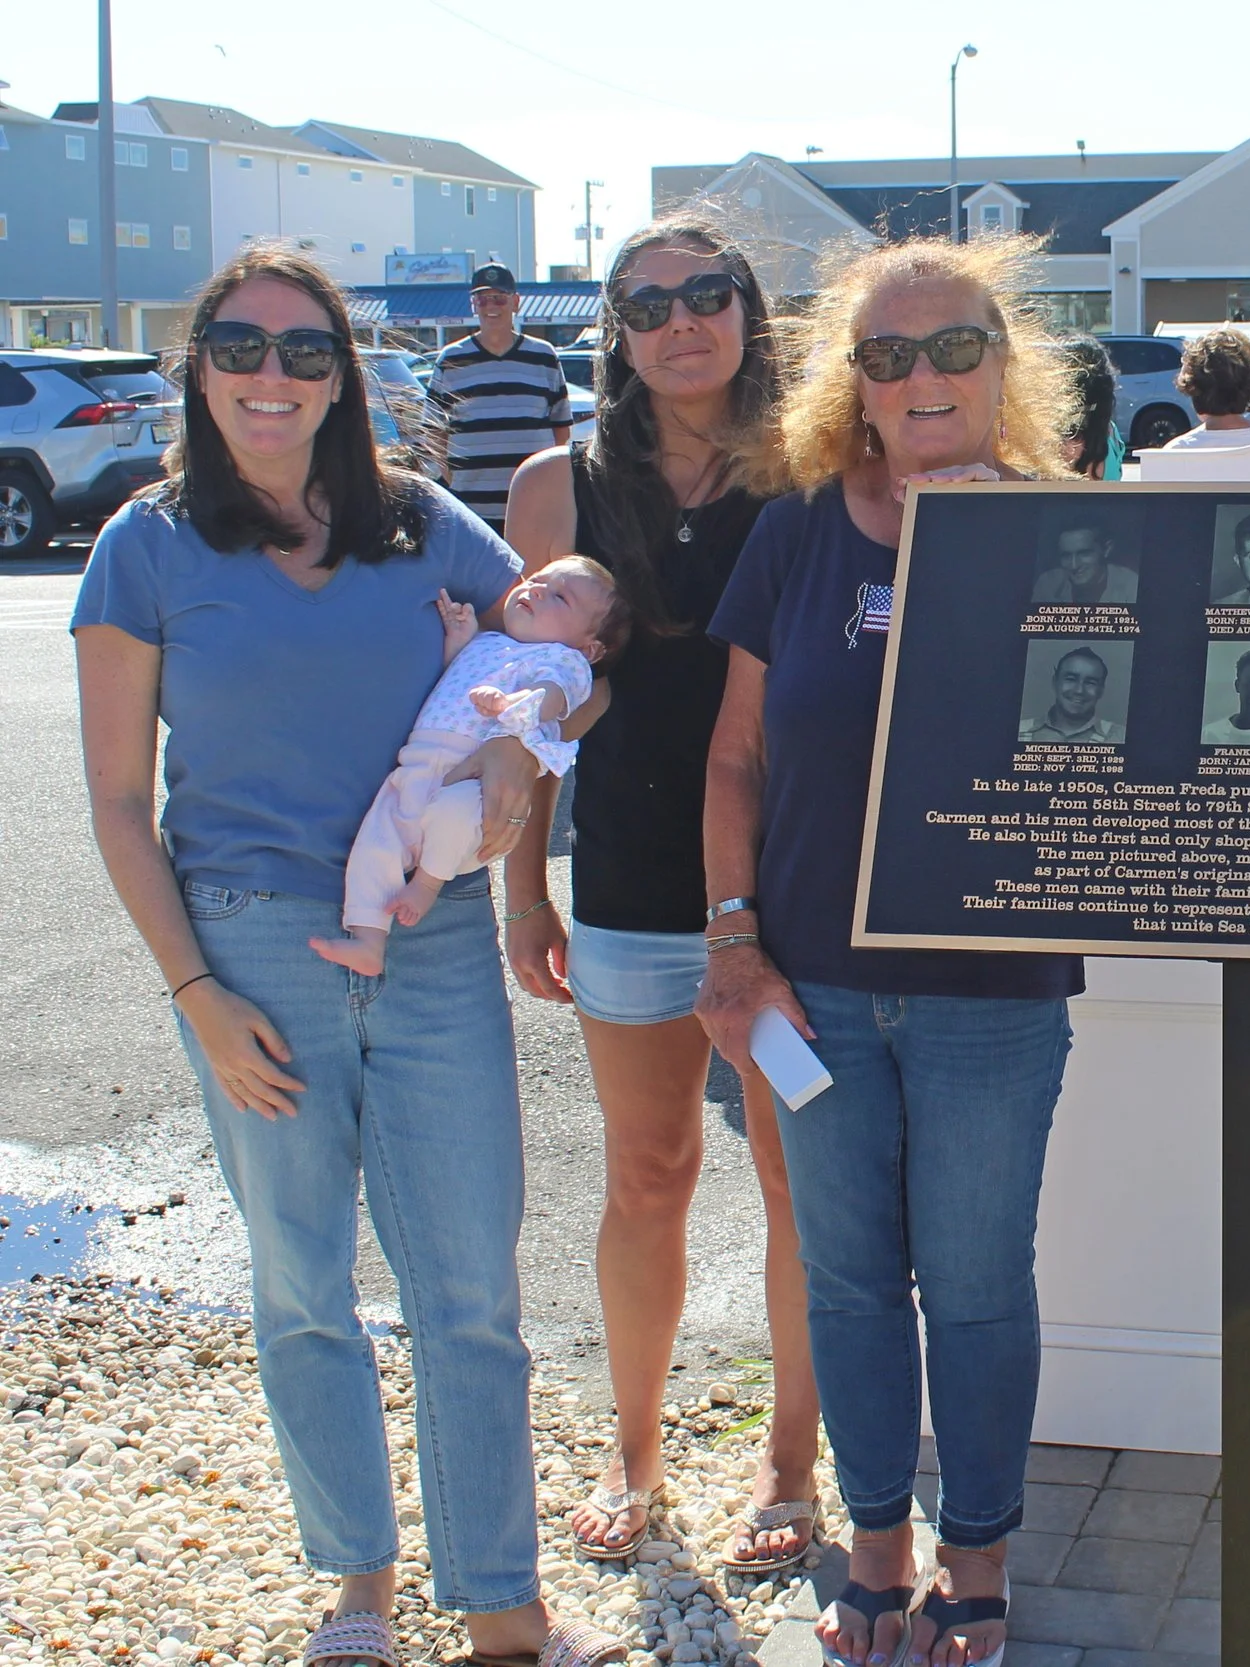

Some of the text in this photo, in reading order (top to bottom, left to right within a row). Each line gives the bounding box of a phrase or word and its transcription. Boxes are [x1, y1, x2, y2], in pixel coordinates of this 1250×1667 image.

[1026, 615, 1057, 623] BORN:
[1085, 616, 1110, 624] 15TH,
[1020, 624, 1044, 632] DIED
[1088, 625, 1115, 633] 24TH,
[1209, 626, 1234, 634] DIED
[1025, 745, 1115, 754] MICHAEL BALDINI
[1214, 748, 1250, 756] FRANK
[1013, 754, 1044, 762] BORN:
[1047, 754, 1074, 762] SEPT.
[1076, 755, 1099, 764] 3RD,
[1199, 757, 1231, 765] BORN:
[1013, 763, 1041, 771] DIED:
[1043, 764, 1066, 772] NOV
[1071, 765, 1098, 773] 10TH,
[973, 778, 990, 791] In
[995, 779, 1019, 791] the
[1024, 780, 1052, 792] late
[1058, 782, 1108, 795] 1950s,
[1114, 782, 1175, 795] Carmen
[1179, 783, 1226, 795] Freda
[1049, 797, 1088, 809] from
[1093, 799, 1129, 810] 58th
[1133, 799, 1180, 811] Street
[1185, 800, 1201, 812] to
[1206, 801, 1243, 813] 79th
[926, 811, 986, 824] Carmen
[991, 813, 1020, 825] and
[1024, 813, 1049, 825] his
[1054, 816, 1088, 826] men
[1092, 815, 1169, 831] developed
[1174, 817, 1213, 829] most
[1218, 818, 1235, 829] of
[968, 828, 990, 841] He
[994, 829, 1026, 842] also
[1030, 830, 1067, 843] built
[1072, 831, 1097, 843] the
[1101, 831, 1136, 844] first
[1140, 833, 1170, 845] and
[1175, 834, 1211, 849] only
[1037, 847, 1066, 859] The
[1071, 851, 1105, 860] men
[1108, 849, 1176, 864] pictured
[1181, 851, 1230, 865] above,
[1034, 866, 1052, 876] as
[1055, 865, 1090, 879] part
[1094, 865, 1111, 877] of
[1115, 866, 1189, 880] Carmen's
[995, 879, 1041, 893] These
[1045, 884, 1079, 894] men
[1084, 885, 1125, 895] came
[1130, 884, 1166, 896] with
[1171, 884, 1210, 897] their
[963, 896, 1006, 909] Their
[1010, 897, 1073, 911] families
[1078, 900, 1148, 913] continue
[1153, 901, 1168, 913] to
[1173, 904, 1250, 917] represent
[1133, 918, 1166, 931] that
[1171, 919, 1213, 932] unite
[1218, 920, 1246, 933] Sea
